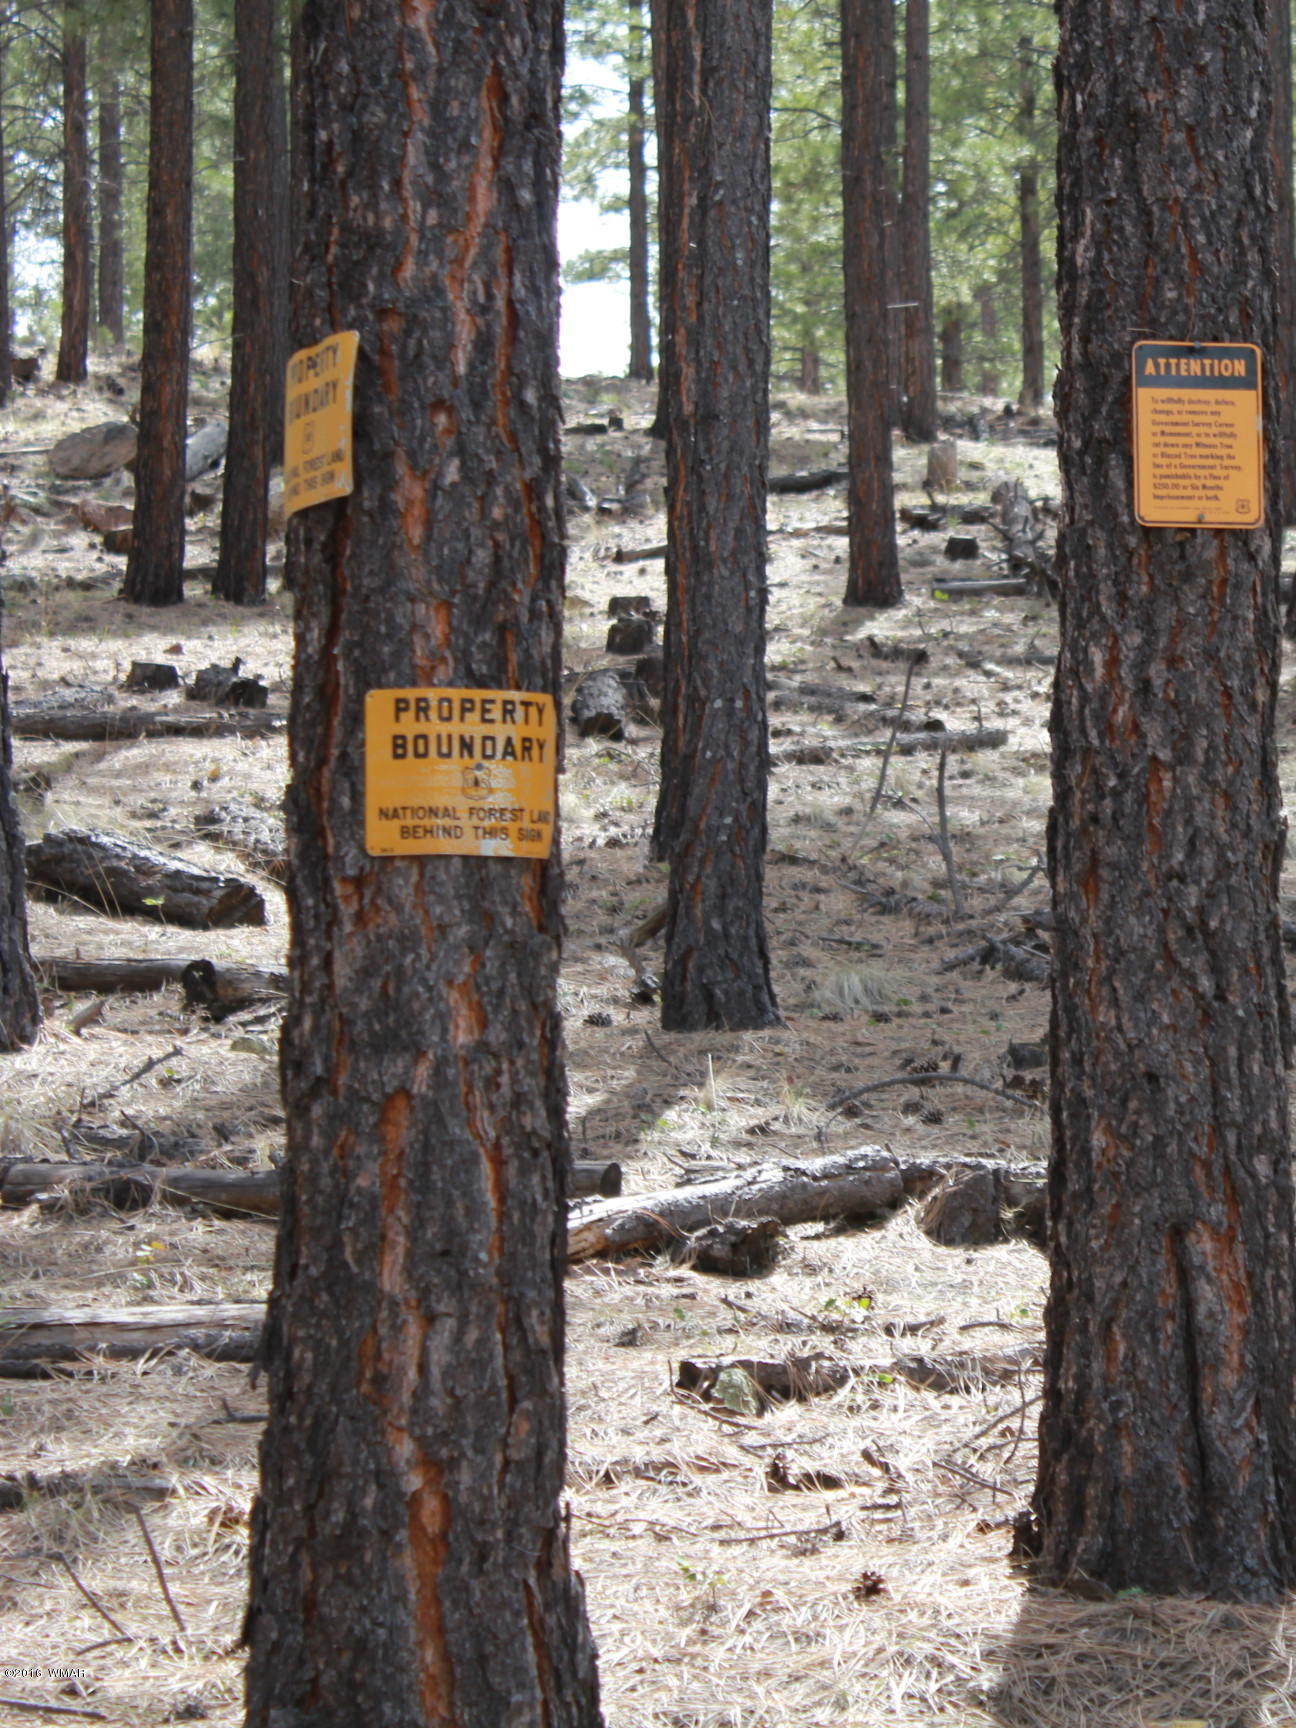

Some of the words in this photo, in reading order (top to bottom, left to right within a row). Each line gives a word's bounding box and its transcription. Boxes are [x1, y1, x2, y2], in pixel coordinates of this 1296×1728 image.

[1144, 358, 1246, 376] ATTENTION
[393, 697, 546, 727] PROPERTY
[392, 734, 546, 763] BOUNDARY
[378, 806, 460, 821] NATIONAL
[468, 807, 525, 823] FOREST
[400, 825, 464, 840] BEHIND
[473, 826, 509, 842] THIS
[517, 827, 543, 843] SIGN
